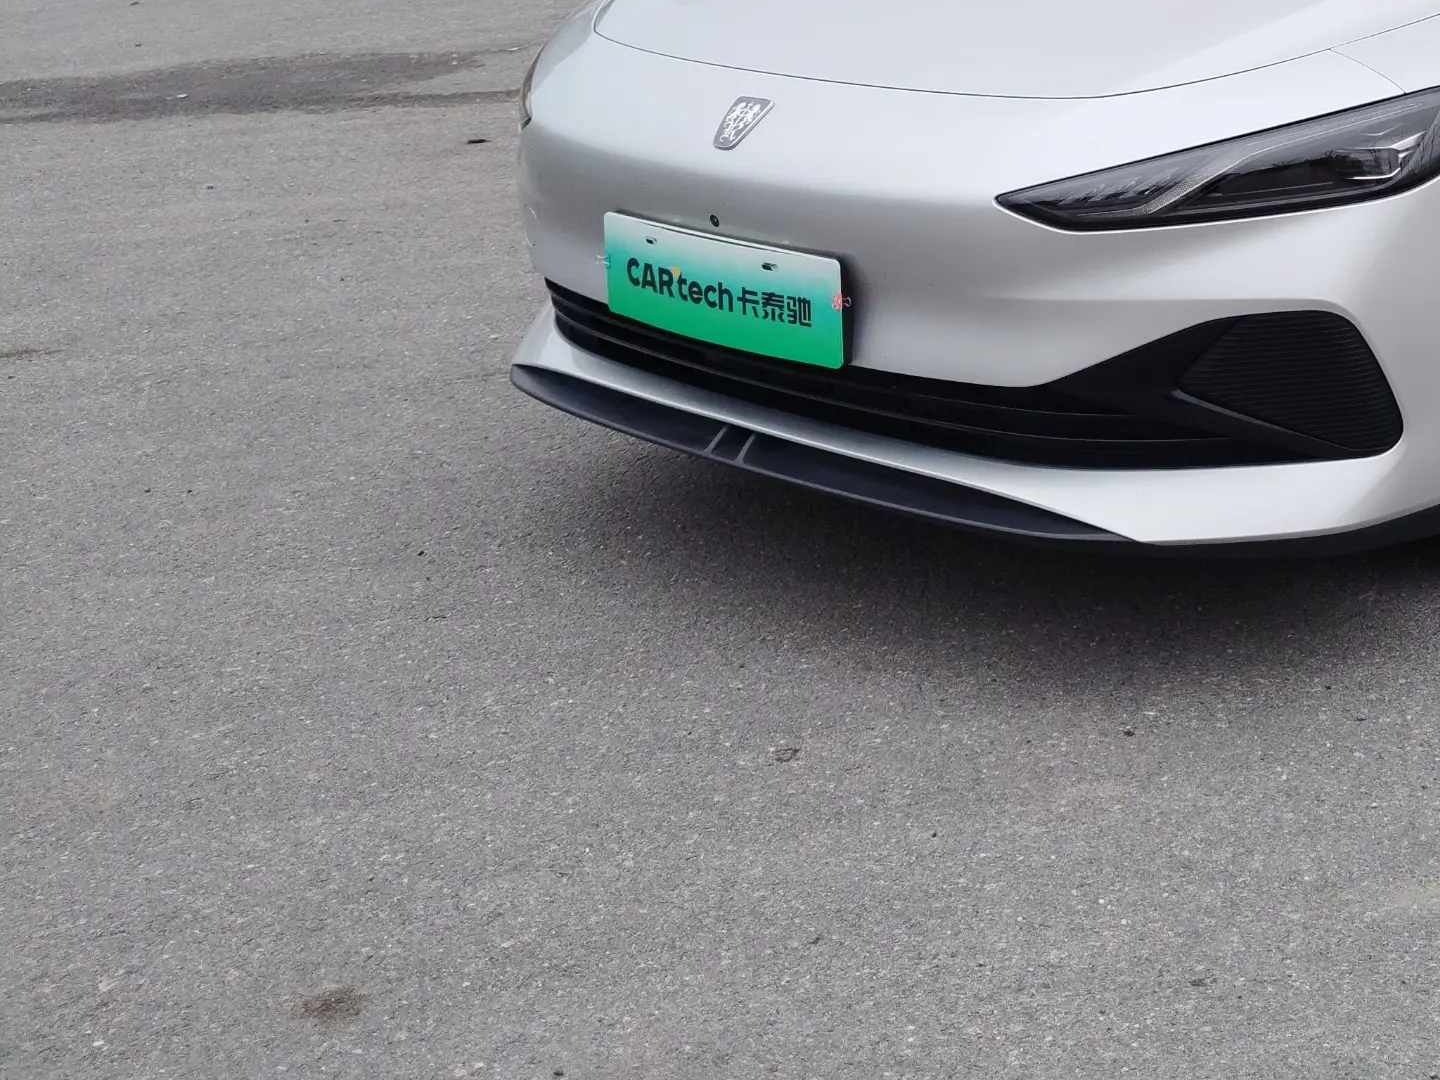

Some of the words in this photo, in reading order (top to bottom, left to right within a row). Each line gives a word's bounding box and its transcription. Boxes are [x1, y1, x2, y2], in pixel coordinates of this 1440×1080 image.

[626, 257, 734, 312] CARtech
[737, 286, 812, 328] 卡泰驰
